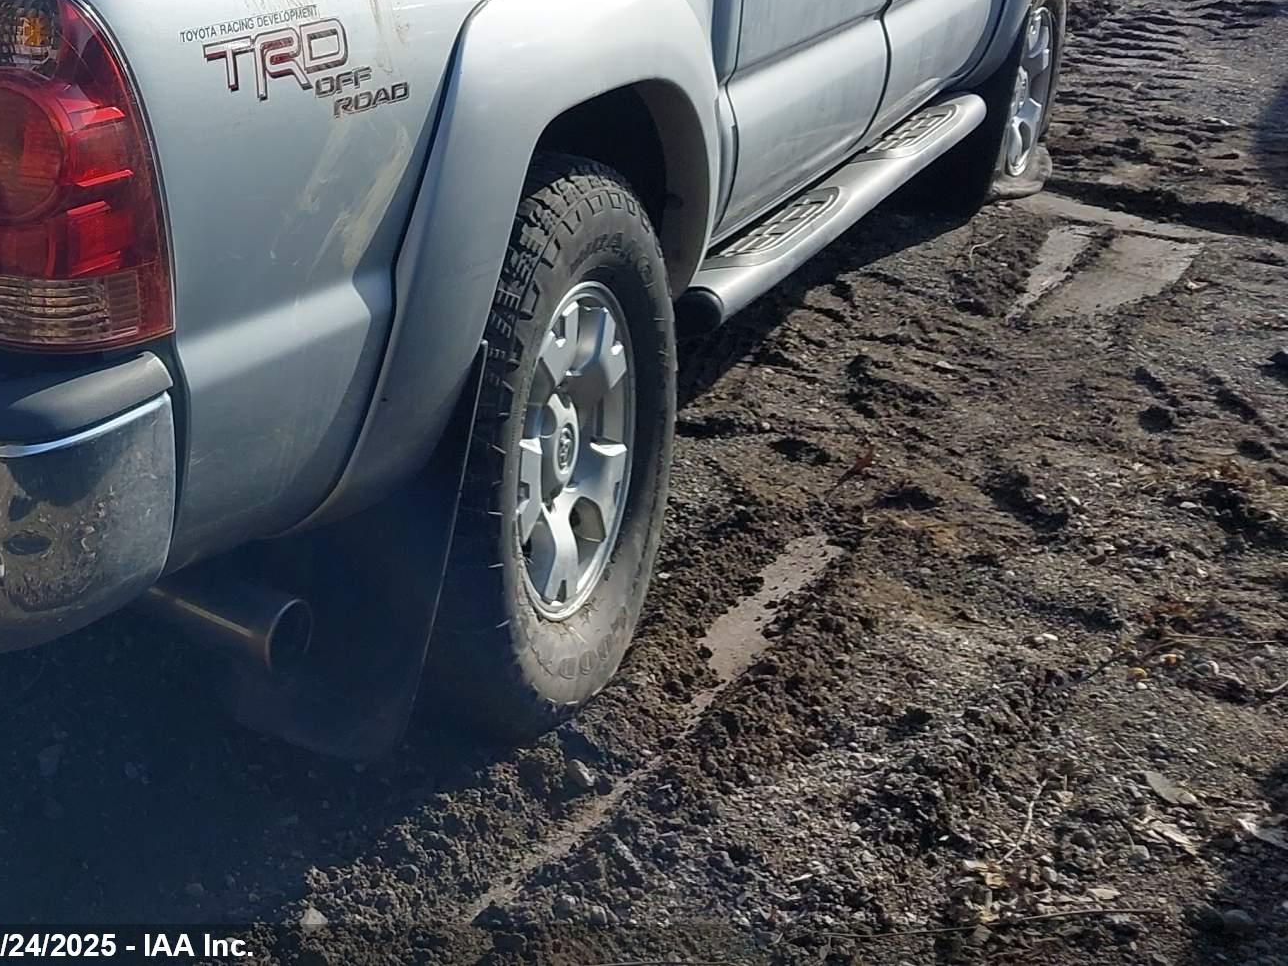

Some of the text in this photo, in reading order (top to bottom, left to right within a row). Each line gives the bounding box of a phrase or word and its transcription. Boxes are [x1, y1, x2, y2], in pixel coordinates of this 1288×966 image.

[180, 4, 320, 43] TOYOTA RACING DEVELOPMENT
[202, 17, 349, 102] TRD
[315, 66, 372, 98] OFF
[333, 81, 410, 118] ROAD
